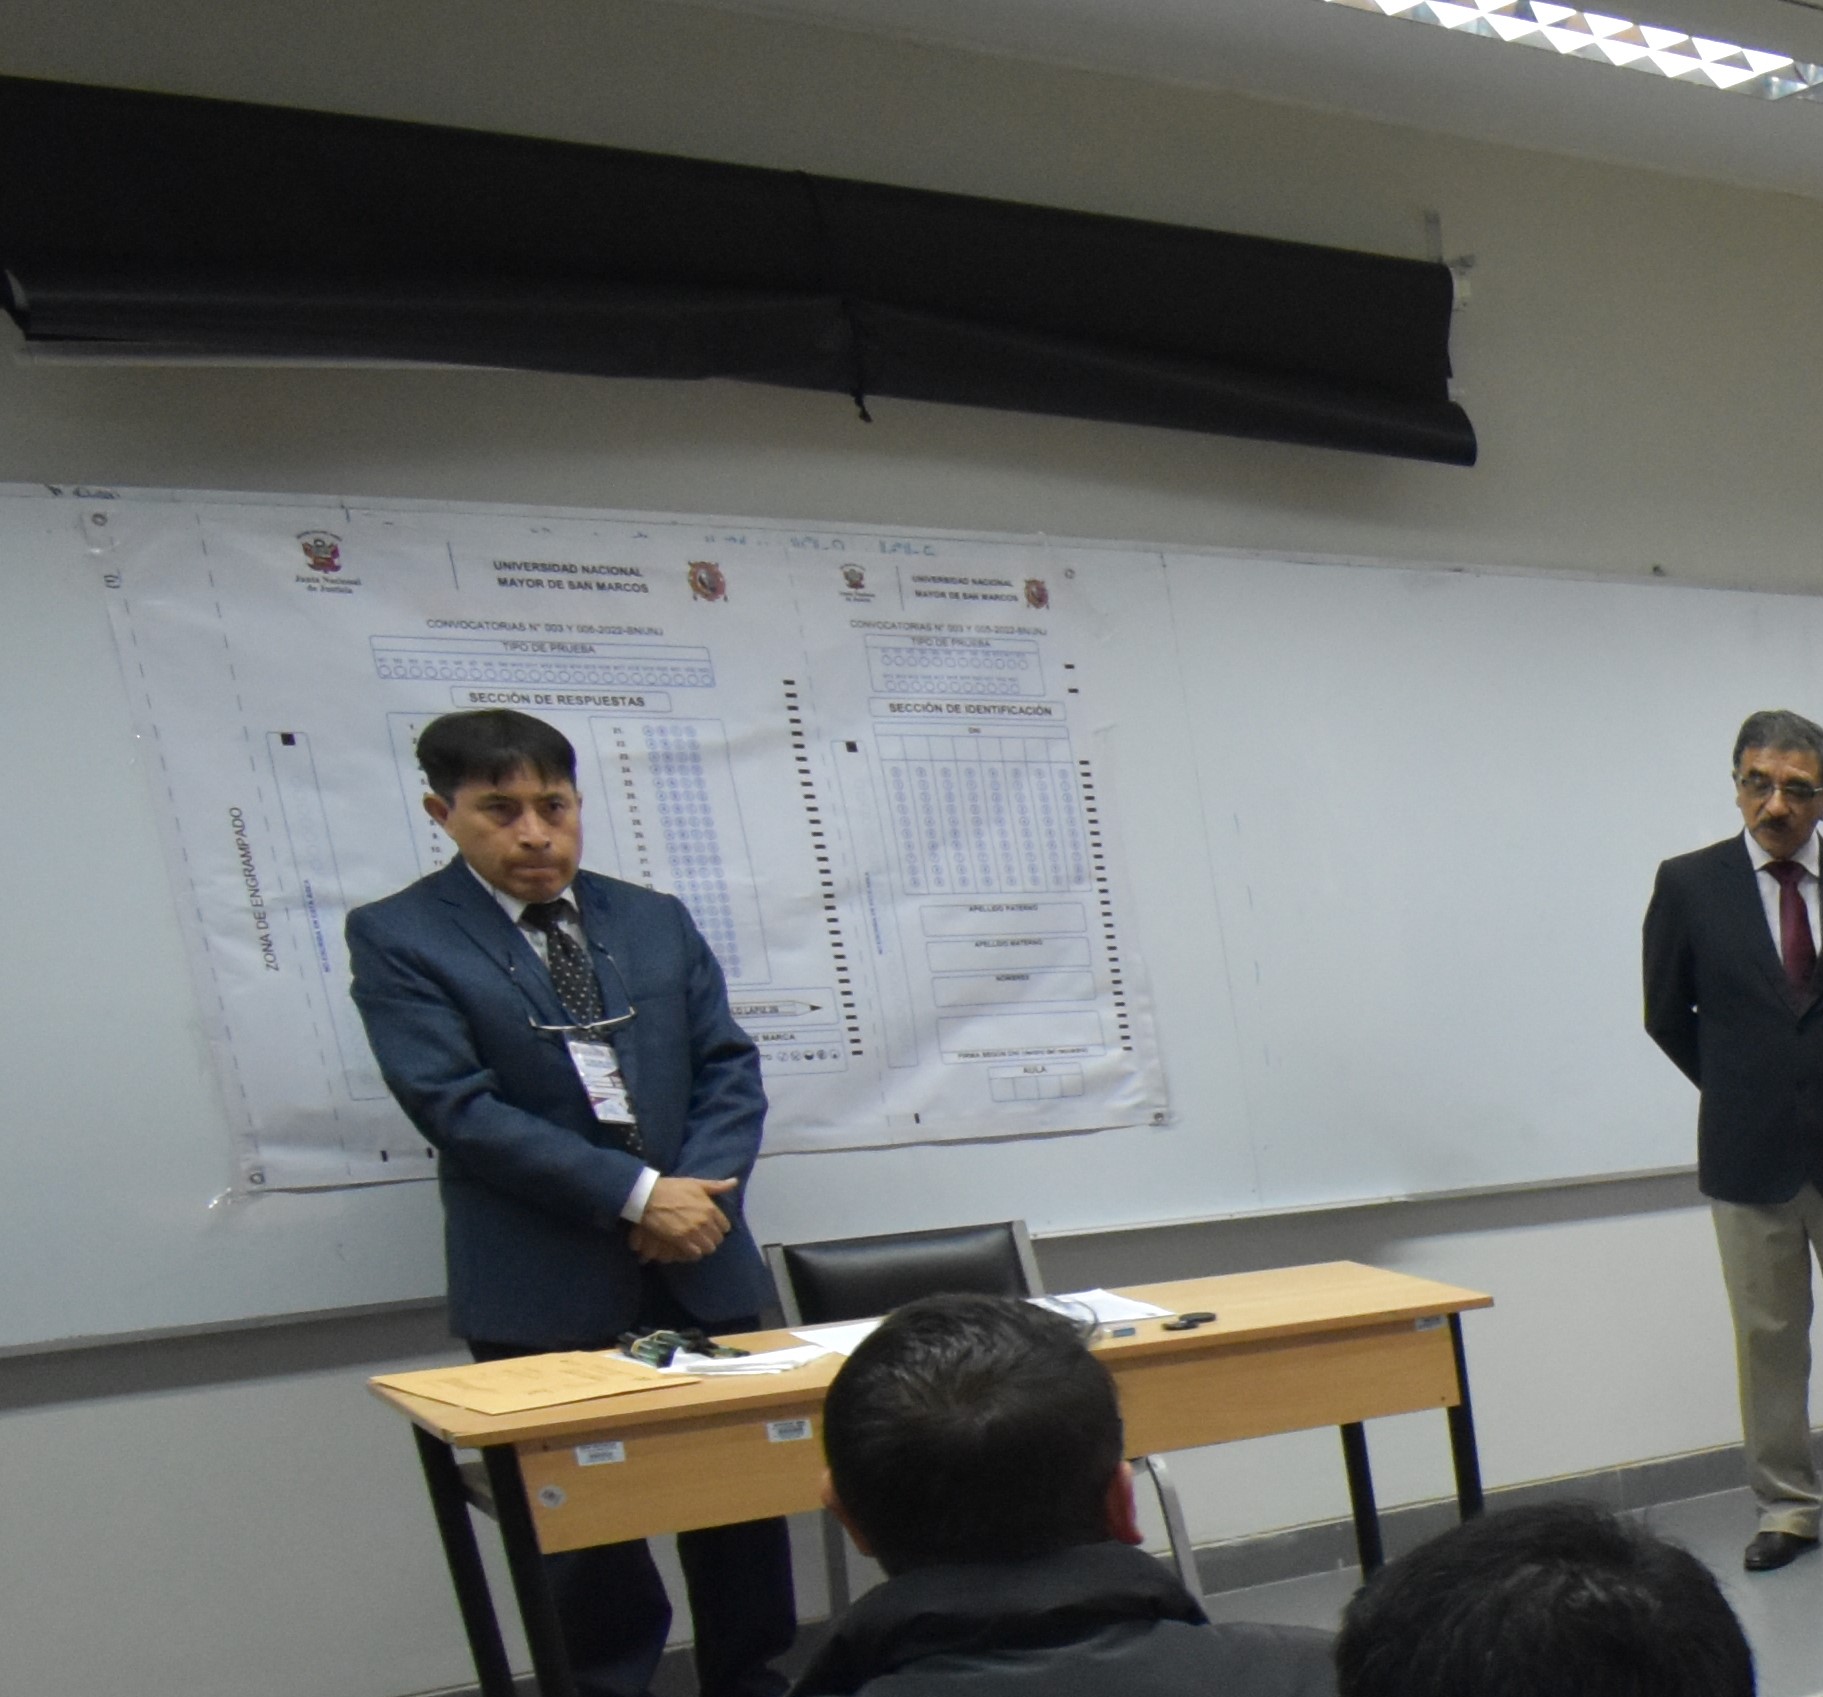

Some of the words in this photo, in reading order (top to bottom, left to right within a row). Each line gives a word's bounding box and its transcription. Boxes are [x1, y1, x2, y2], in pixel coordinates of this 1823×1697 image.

[493, 560, 578, 575] UNIVERSIDAD
[581, 563, 644, 578] NACIONAL
[496, 577, 545, 589] MAYOR
[548, 579, 565, 589] DE
[568, 579, 593, 591] SAN
[595, 581, 650, 594] MARCOS
[426, 618, 527, 632] CONVOCATORIAS
[849, 619, 932, 632] CONVOCATORIAS
[502, 640, 530, 651] TIPO
[531, 642, 546, 652] DE
[549, 642, 596, 655] PRUEBA
[912, 637, 934, 647] TIPO
[951, 638, 991, 648] PRUEBA
[468, 689, 533, 704] SECCIÓN
[536, 692, 554, 705] DE
[556, 693, 646, 707] RESPUESTAS
[888, 701, 944, 714] SECCIÓN
[946, 703, 962, 714] DE
[964, 702, 1052, 717] IDENTIFICACIÓN
[228, 807, 265, 908] ENGRAMPADO
[252, 911, 269, 931] DE
[260, 933, 280, 972] ZONA
[762, 1032, 796, 1042] MARCA
